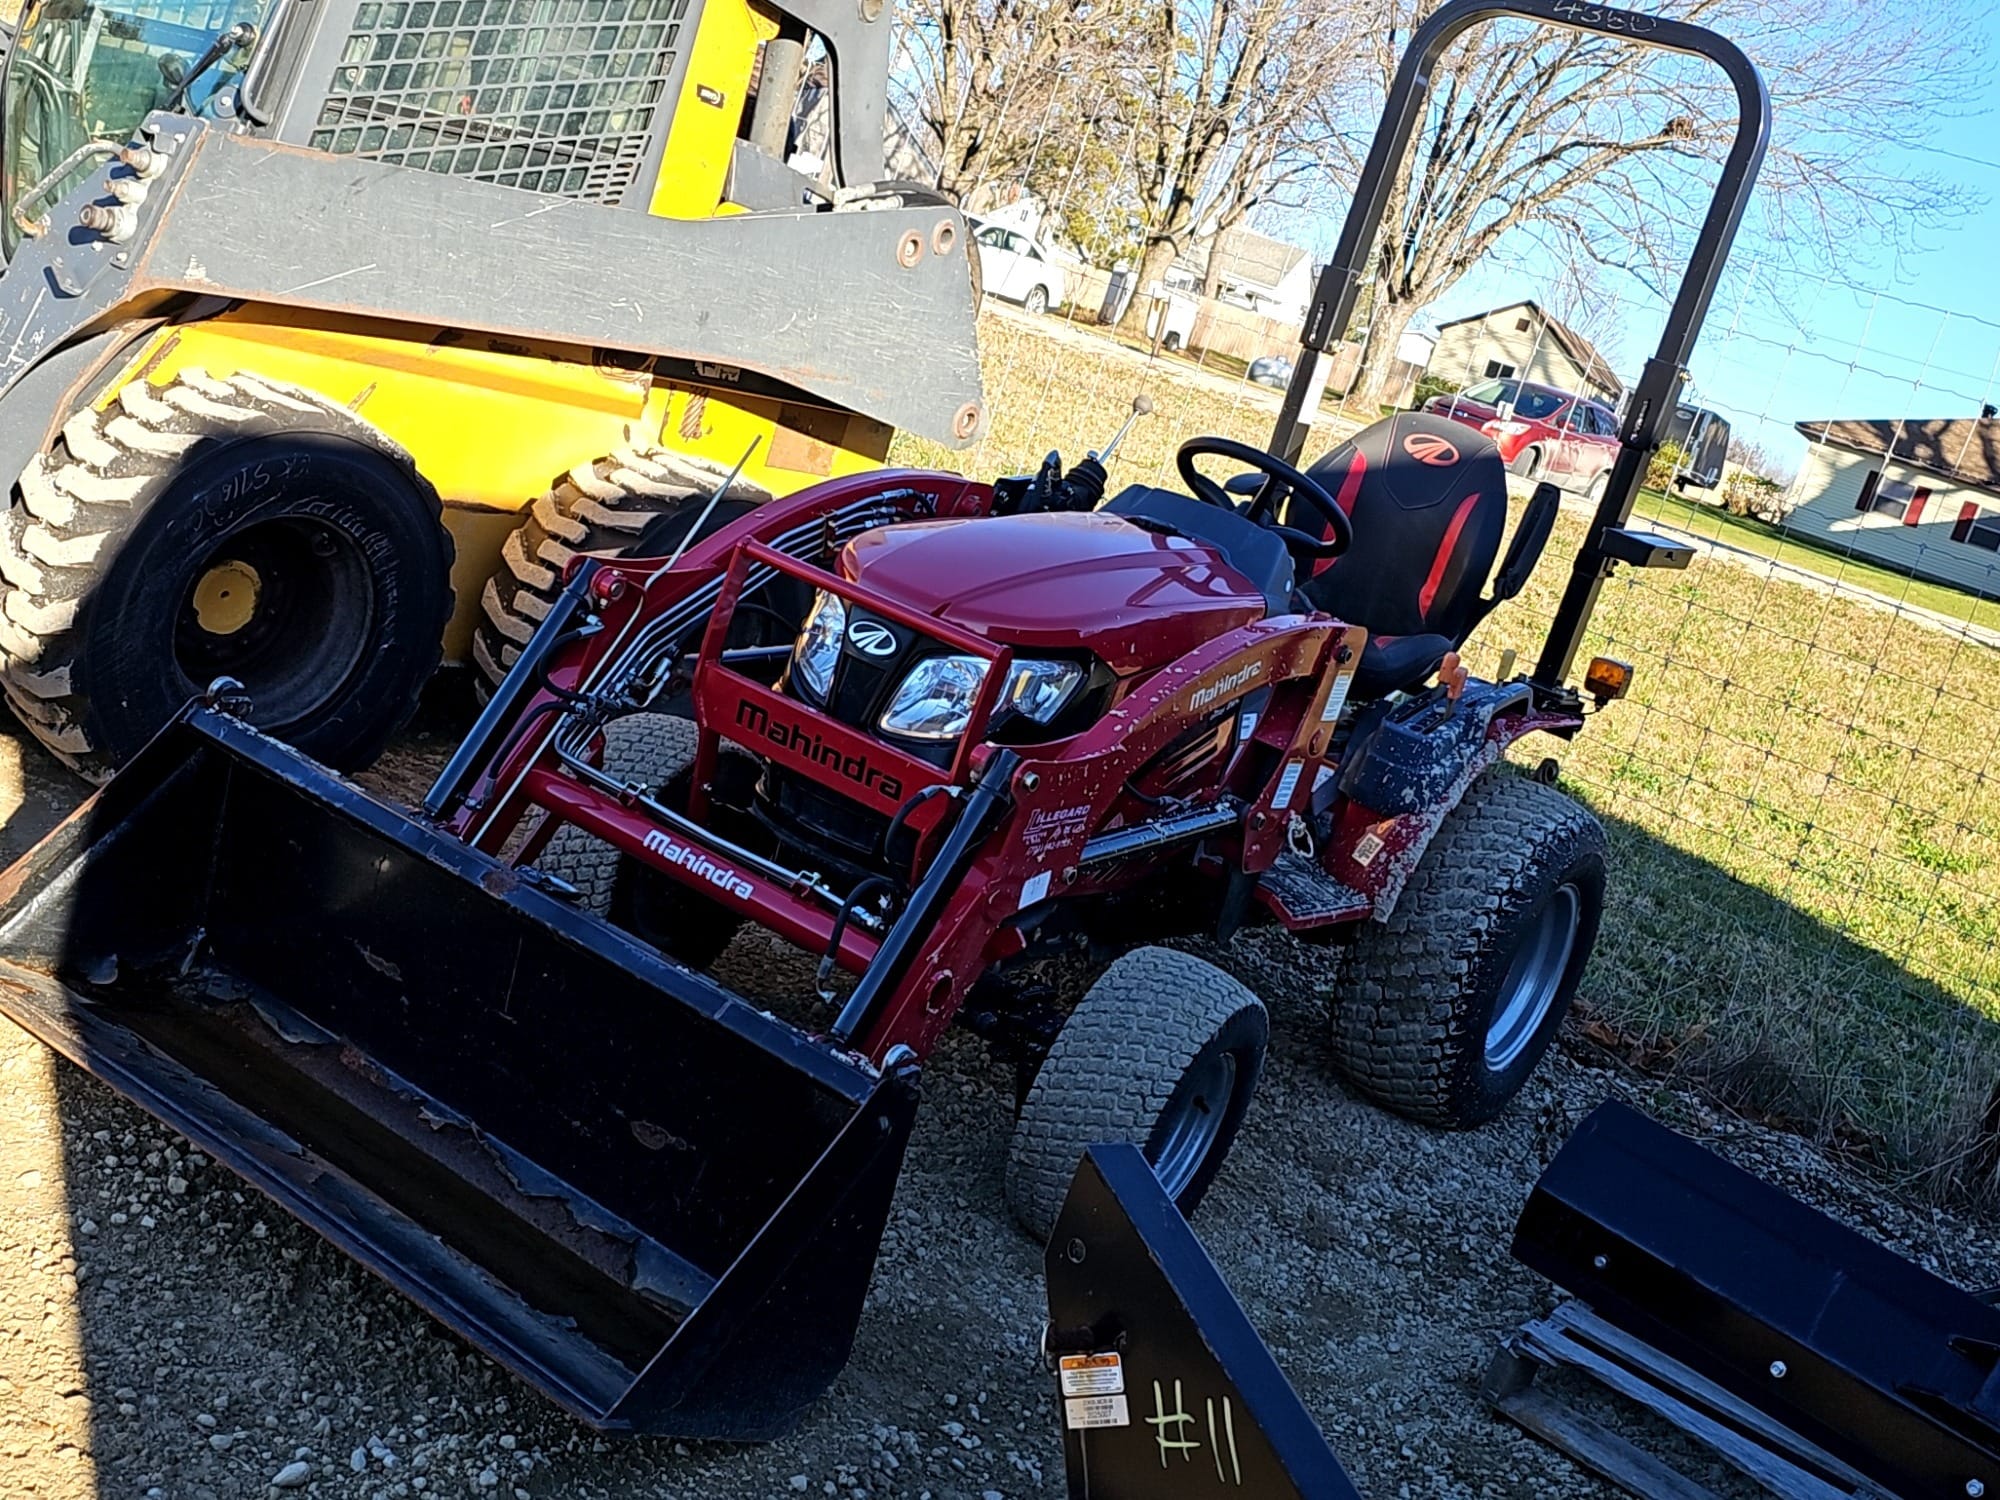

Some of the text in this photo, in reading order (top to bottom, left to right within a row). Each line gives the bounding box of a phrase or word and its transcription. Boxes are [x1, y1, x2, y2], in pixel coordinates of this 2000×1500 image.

[1189, 660, 1262, 712] Mahindra
[735, 698, 903, 801] Mahindra
[642, 829, 754, 900] Mahindra
[1144, 1379, 1241, 1486] #11
